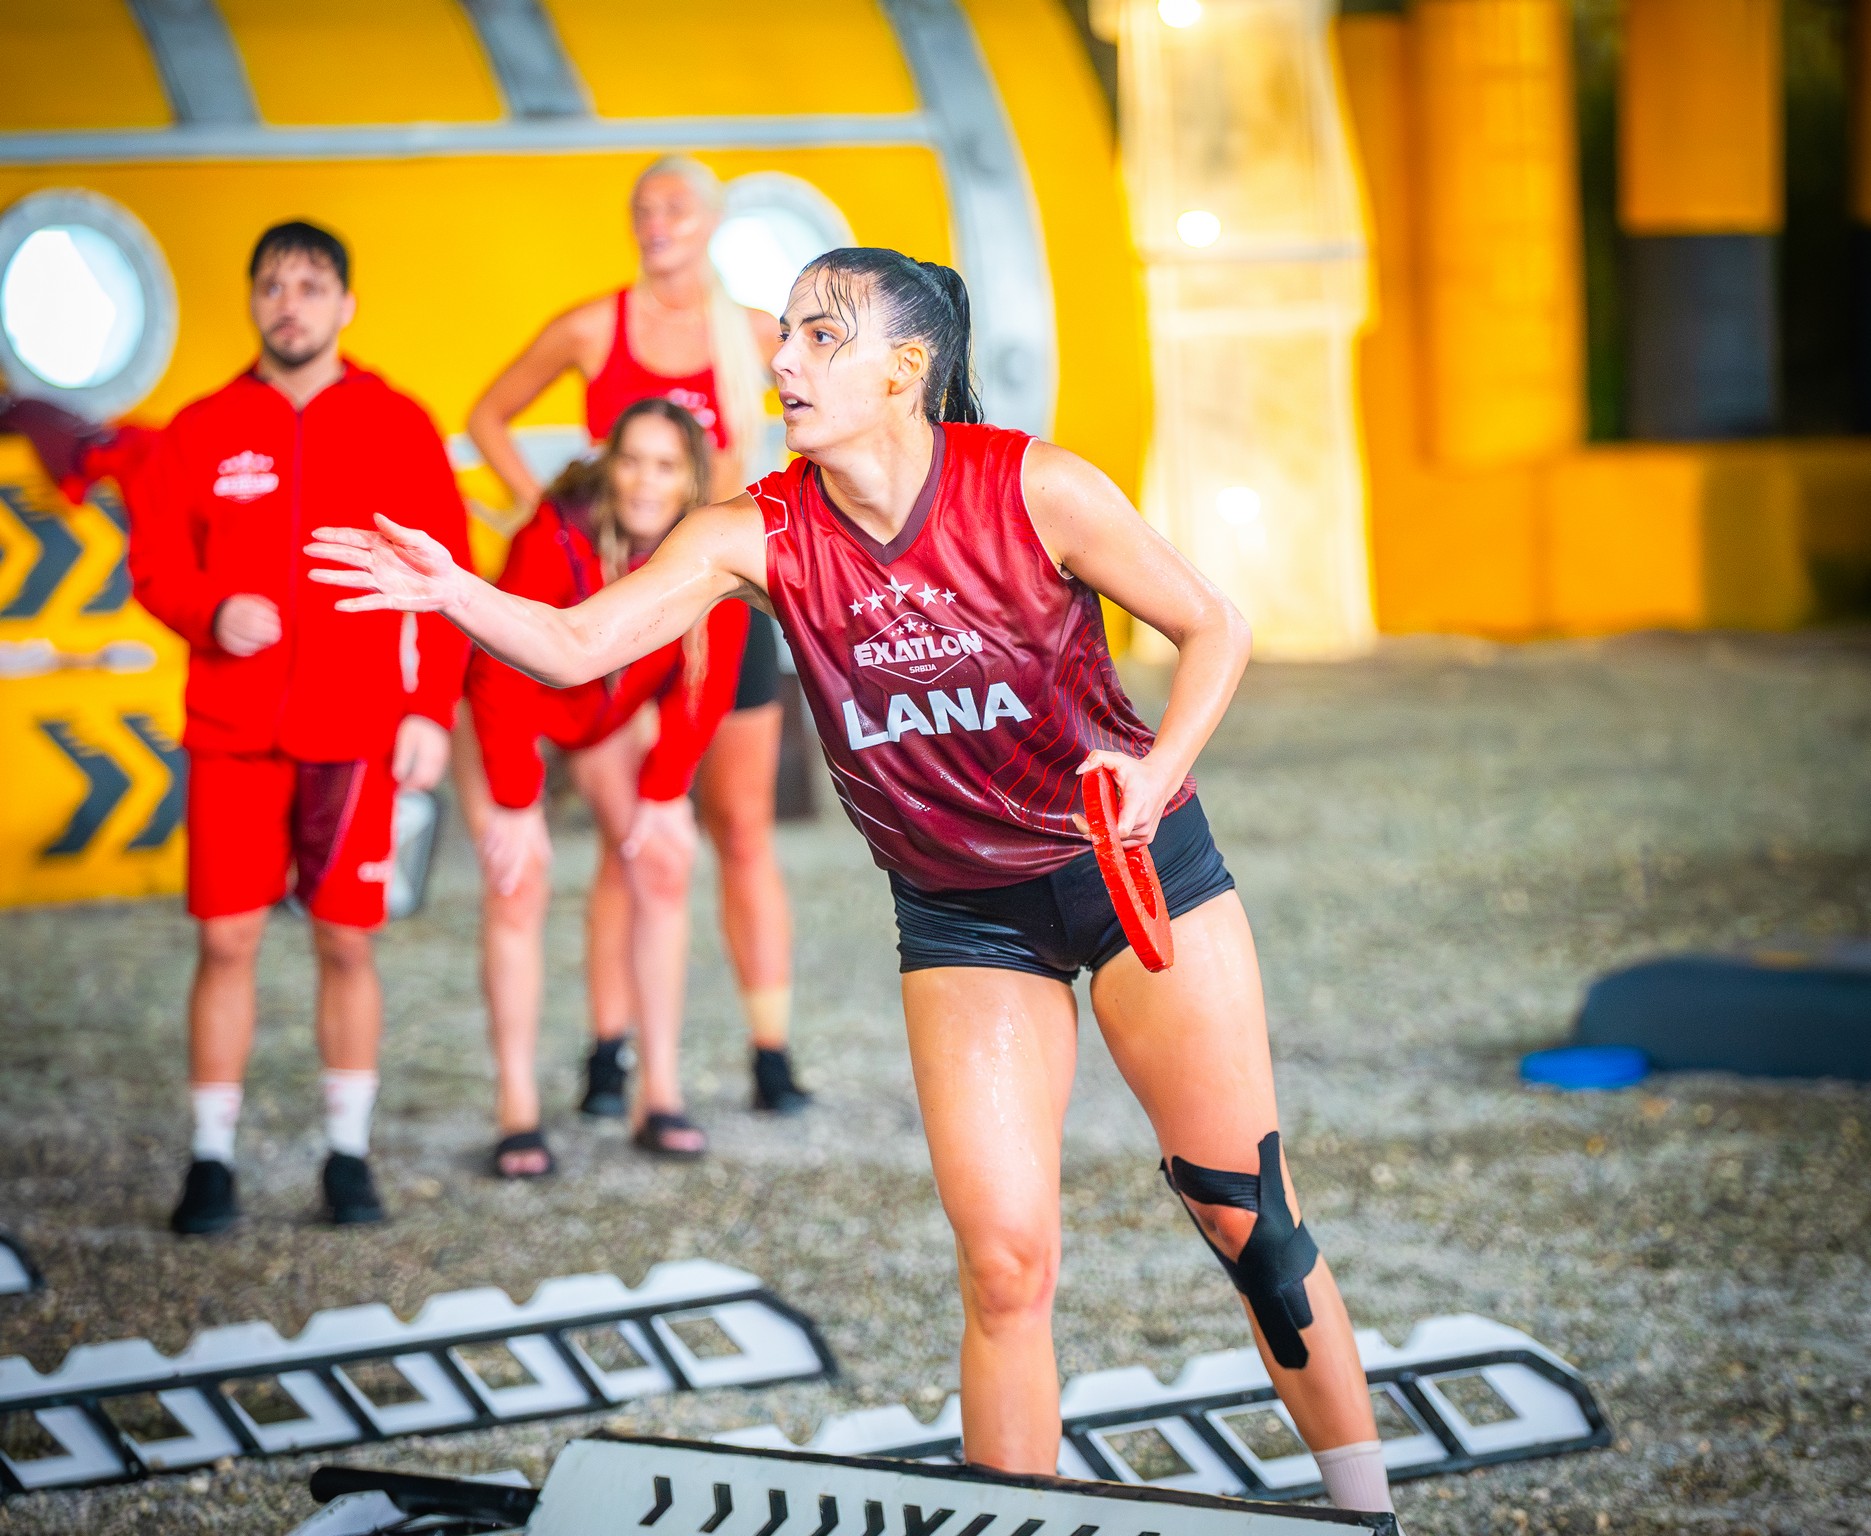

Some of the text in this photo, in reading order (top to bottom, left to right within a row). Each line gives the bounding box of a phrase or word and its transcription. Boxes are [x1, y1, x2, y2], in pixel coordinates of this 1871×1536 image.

[855, 630, 983, 667] EXATLON
[909, 663, 937, 674] SRBIJA
[842, 681, 1032, 750] LANA
